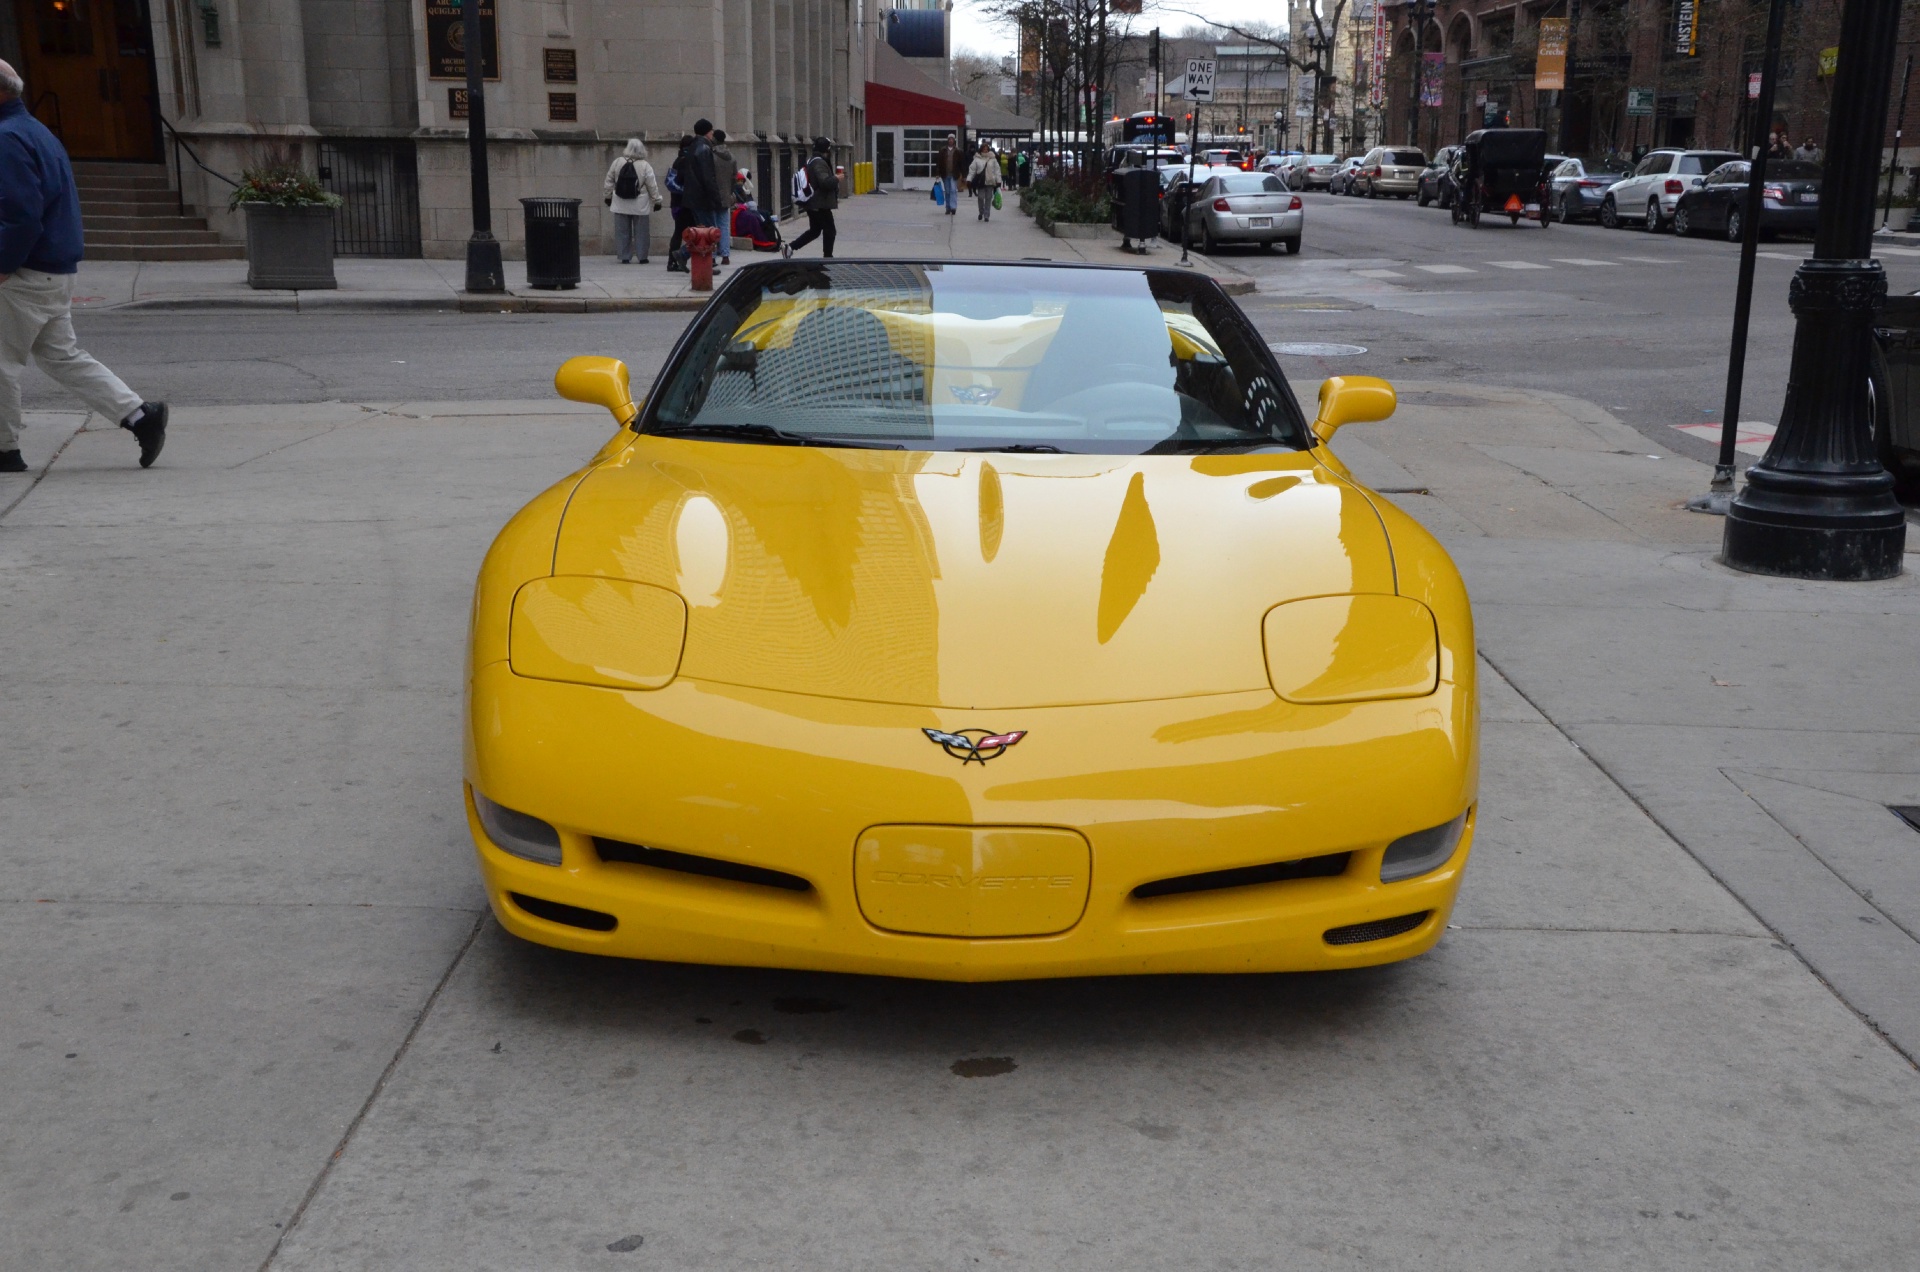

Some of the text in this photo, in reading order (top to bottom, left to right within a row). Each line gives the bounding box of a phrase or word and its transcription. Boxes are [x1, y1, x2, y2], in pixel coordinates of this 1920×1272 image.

[428, 8, 462, 17] QUIGLEY
[1540, 48, 1565, 56] Creche
[1190, 62, 1213, 73] ONE
[1188, 74, 1212, 85] WAY
[871, 871, 1074, 890] CORVETTE
